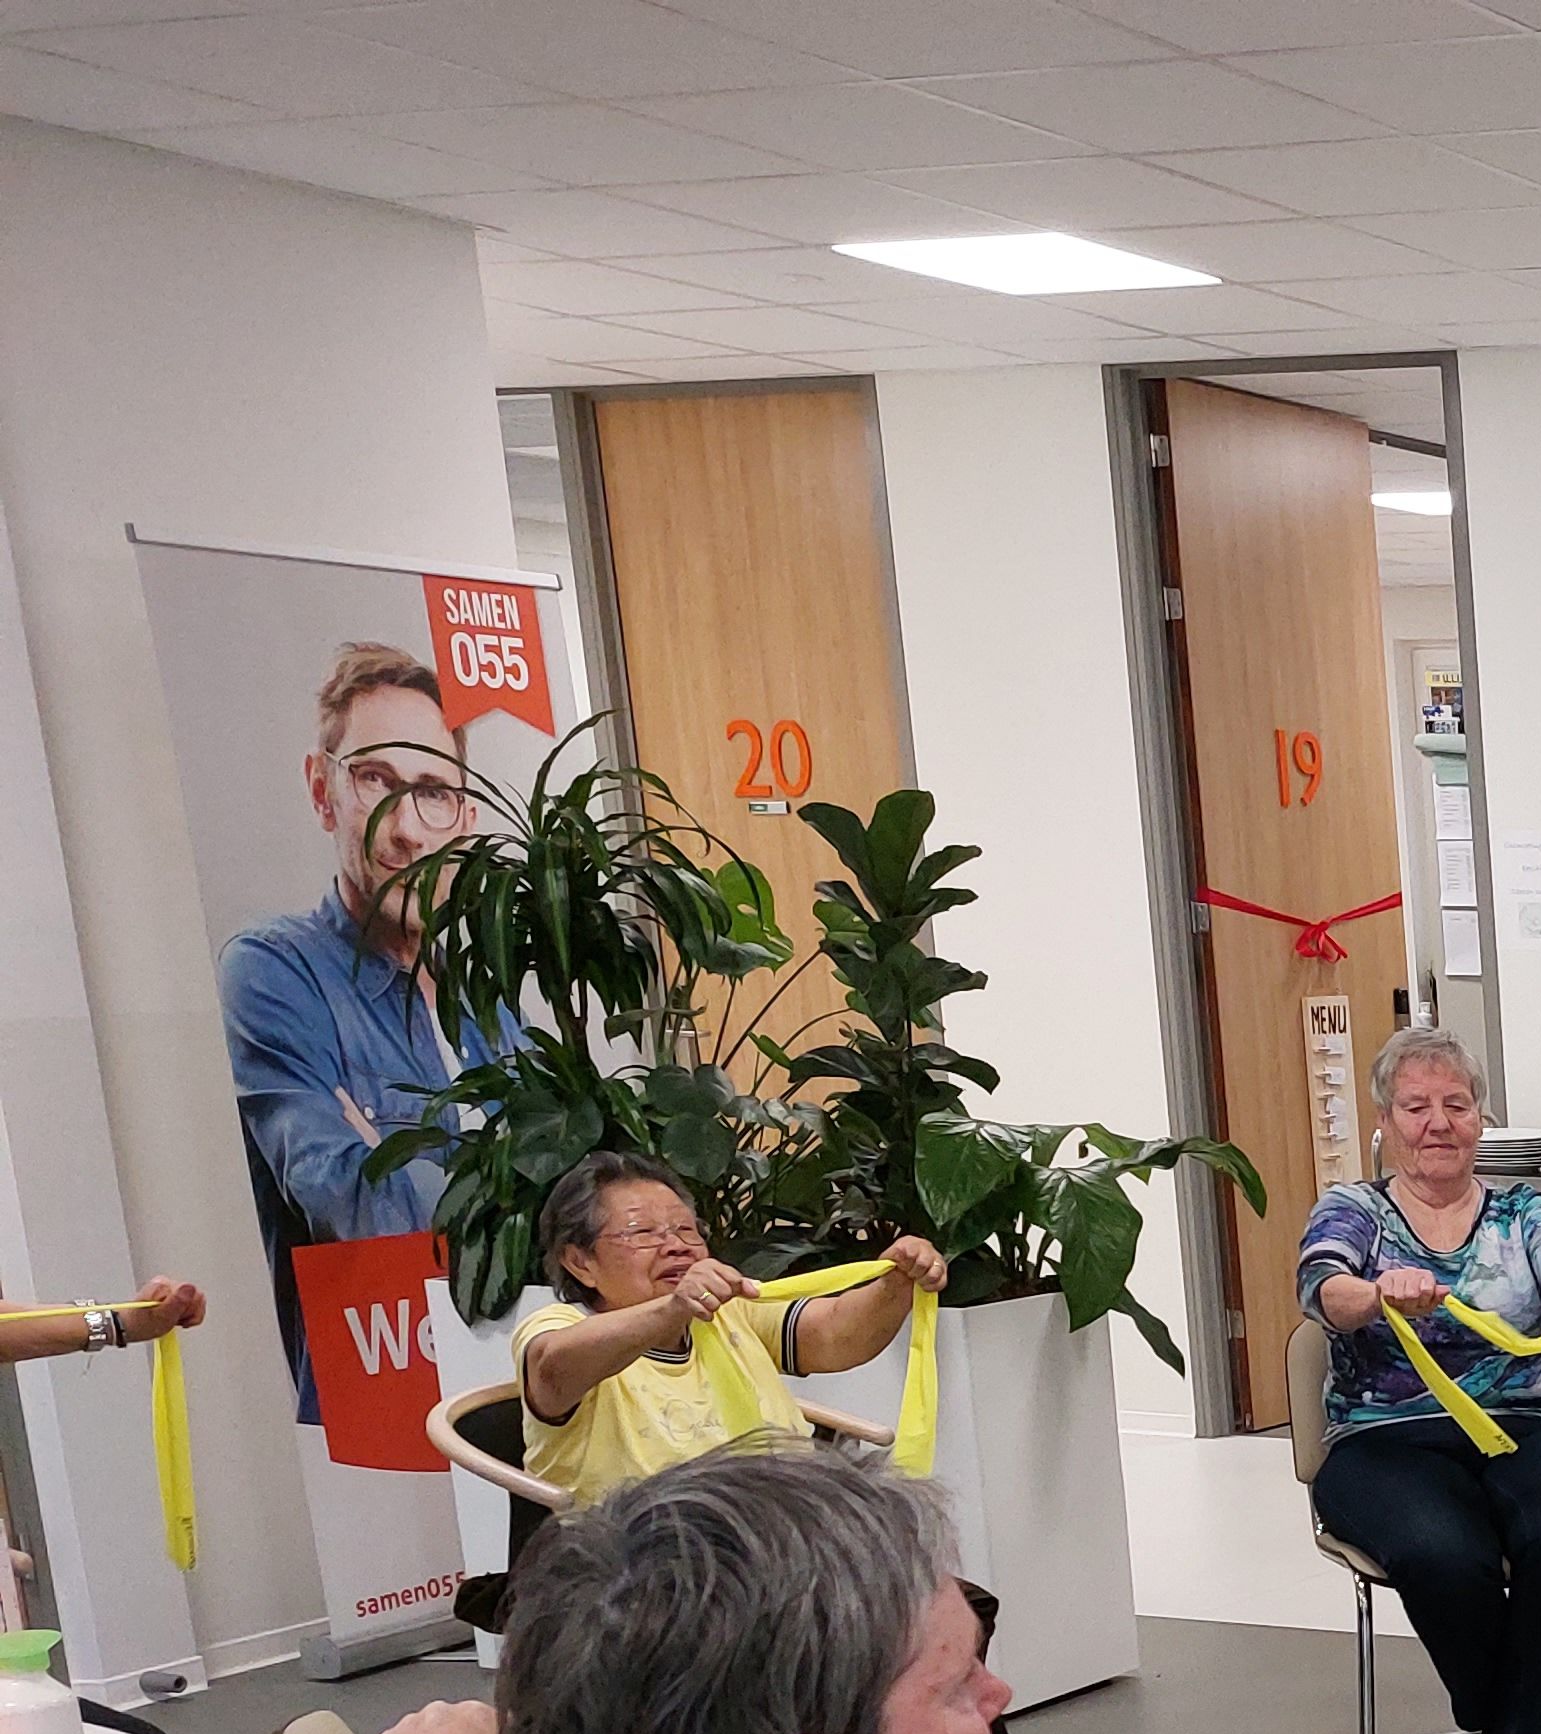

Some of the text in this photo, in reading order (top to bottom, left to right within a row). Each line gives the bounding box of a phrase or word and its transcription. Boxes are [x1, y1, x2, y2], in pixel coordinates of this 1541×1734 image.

[443, 588, 521, 631] SAMEN
[450, 631, 529, 691] 055
[726, 719, 812, 798] 20
[1275, 729, 1323, 808] 19
[1310, 1005, 1347, 1035] MENU
